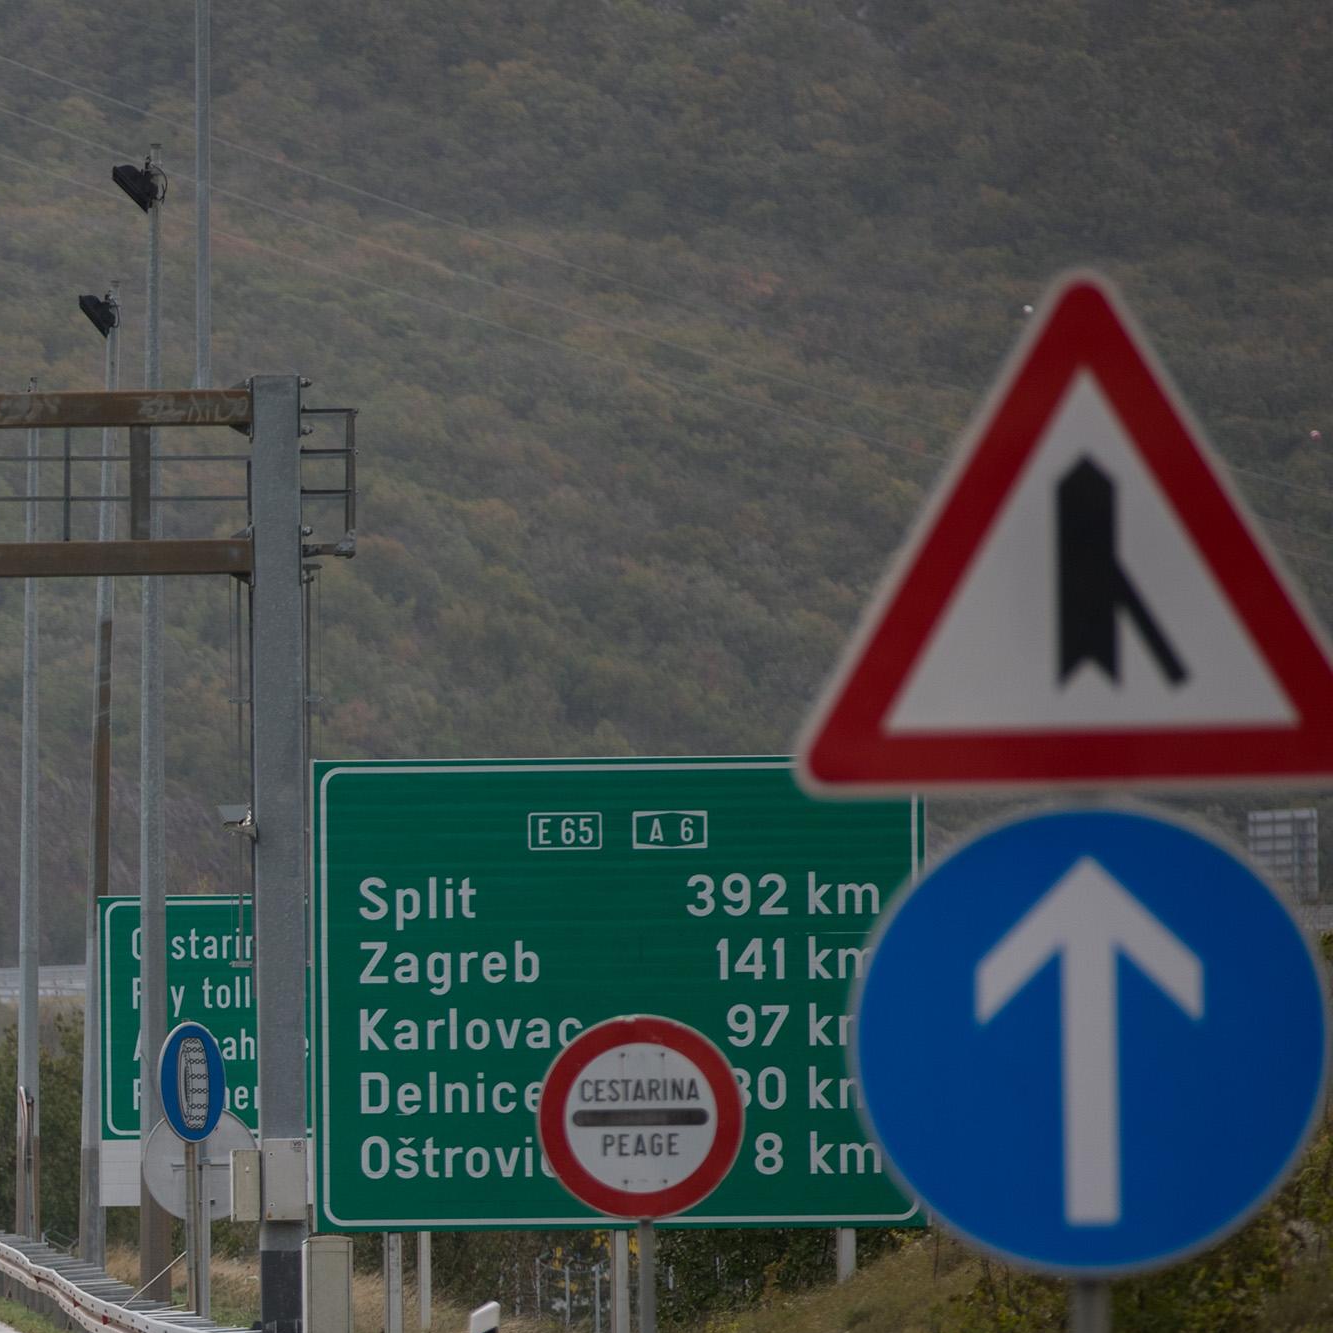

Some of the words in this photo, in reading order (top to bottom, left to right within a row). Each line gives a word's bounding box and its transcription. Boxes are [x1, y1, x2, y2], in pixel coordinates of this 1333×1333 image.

[538, 818, 552, 845] E
[560, 817, 594, 845] 65
[649, 818, 664, 842] A
[680, 817, 694, 842] 6
[359, 876, 477, 931] Split
[686, 872, 789, 917] 392
[807, 871, 880, 915] km
[359, 940, 540, 996] Zagreb
[716, 937, 785, 980] 141
[202, 976, 250, 1009] toll
[359, 1007, 582, 1050] Karlovac
[726, 1003, 789, 1047] 97
[360, 1071, 542, 1114] Delnice
[582, 1078, 700, 1103] CESTARINA
[602, 1132, 680, 1157] PEAGE
[754, 1132, 783, 1175] 8
[810, 1131, 882, 1174] km
